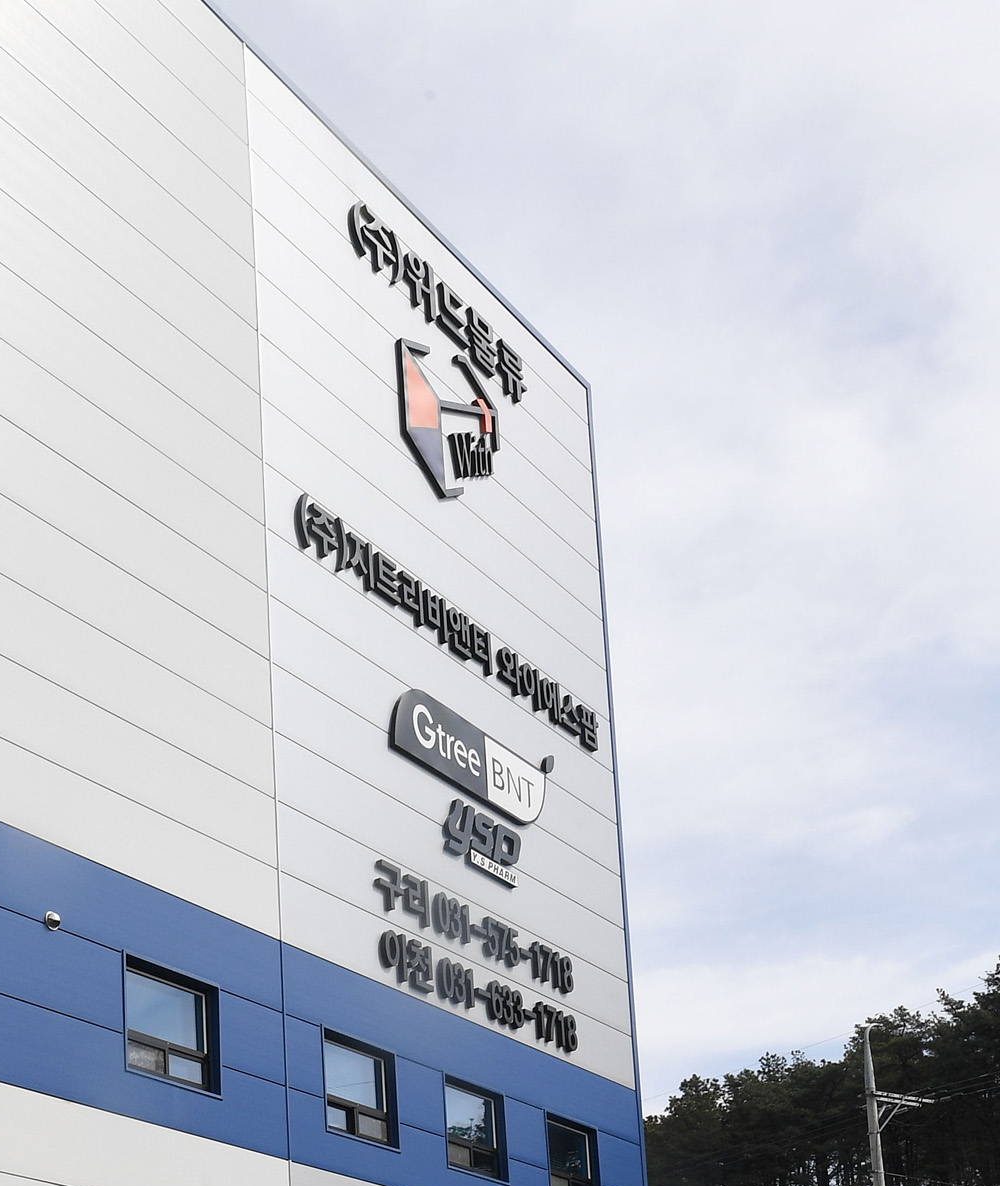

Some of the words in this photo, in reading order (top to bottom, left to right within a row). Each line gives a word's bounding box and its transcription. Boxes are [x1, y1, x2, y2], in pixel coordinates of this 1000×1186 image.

[447, 432, 495, 480] With
[293, 492, 493, 677] (주)지트리비앤티
[496, 645, 599, 752] 와이에스팜
[412, 704, 481, 777] Gtree
[491, 757, 534, 809] BNT
[373, 859, 430, 929] 구리
[432, 891, 575, 994] 031-575-1718
[488, 861, 518, 884] PHARM
[379, 929, 435, 994] 이천
[436, 957, 579, 1053] 031-633-1718
